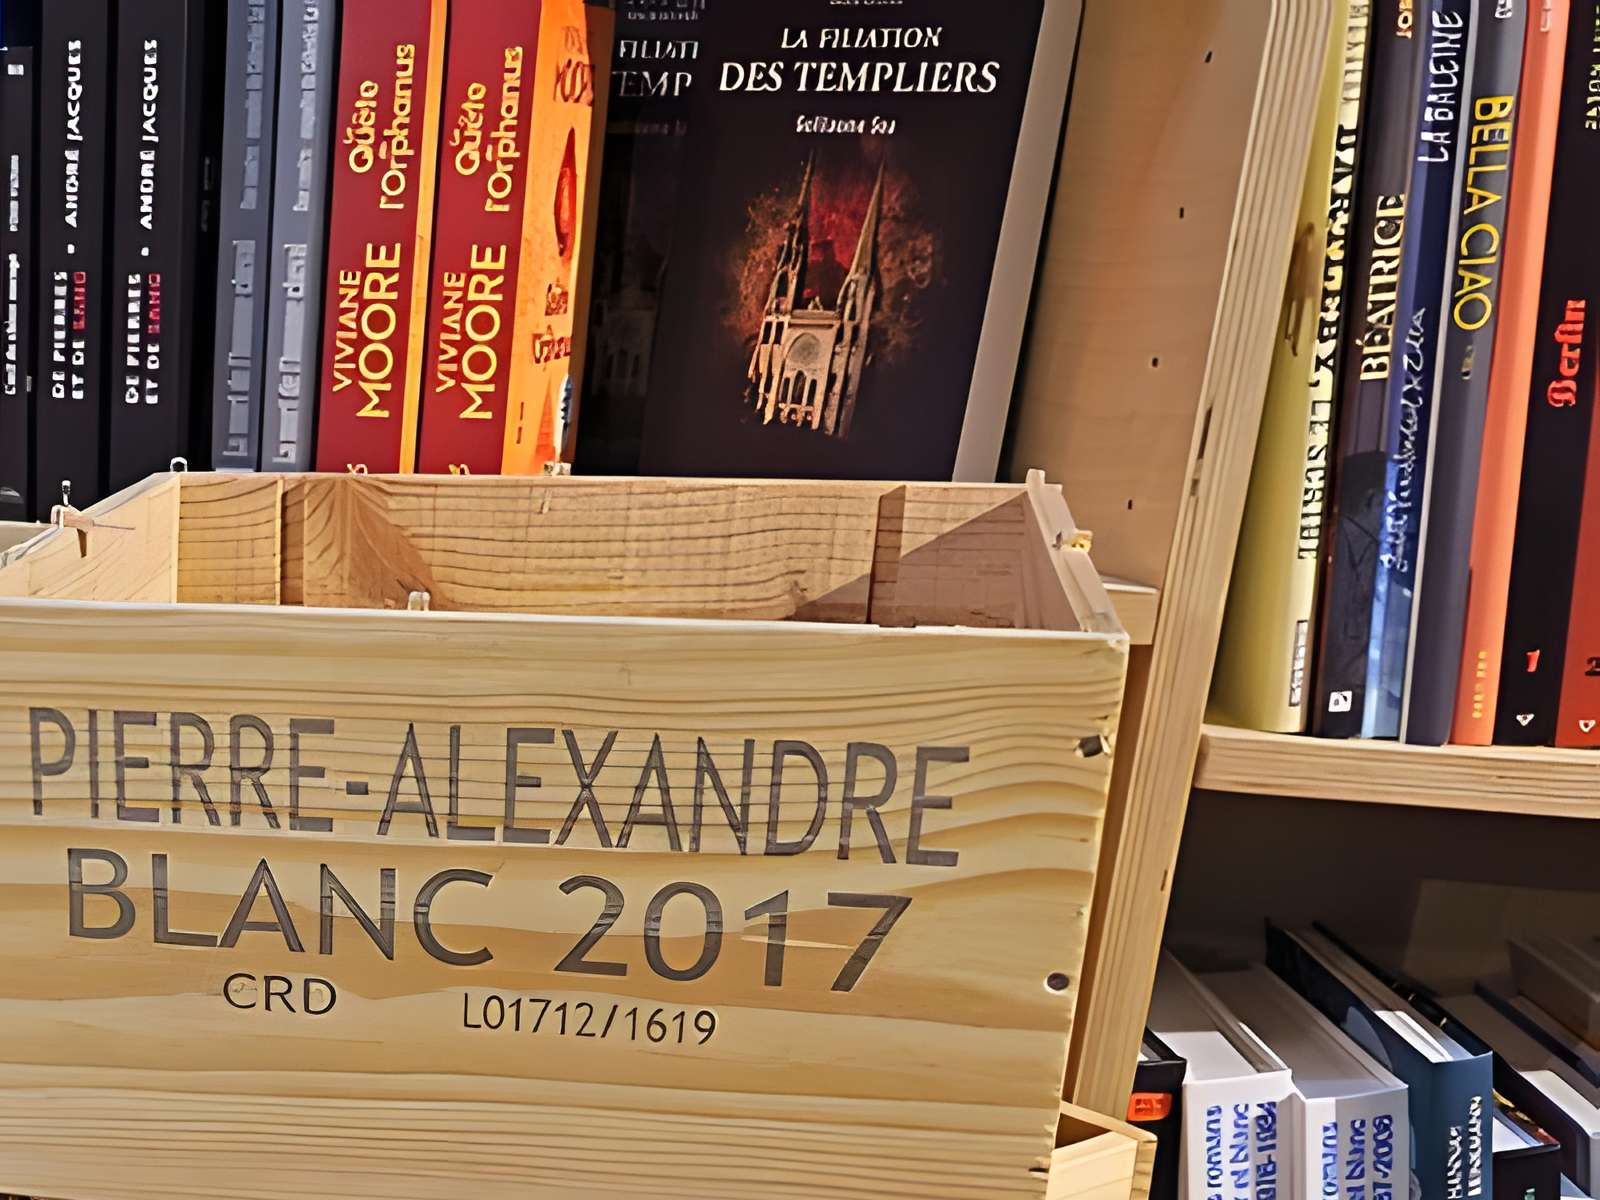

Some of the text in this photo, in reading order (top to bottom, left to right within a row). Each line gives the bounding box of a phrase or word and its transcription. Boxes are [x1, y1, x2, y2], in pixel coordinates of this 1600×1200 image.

[67, 40, 83, 141] JACQUES
[142, 40, 160, 142] JACQUES
[719, 60, 1001, 93] DES TEMPLIERS
[781, 27, 944, 49] LA FILIATION
[1417, 10, 1464, 163] LA BALEINE
[1453, 95, 1514, 332] BELLA CIAO
[332, 270, 362, 391] VIVIANE
[356, 243, 401, 417] MOORE
[435, 272, 467, 392] VIVIANE
[459, 244, 507, 419] MOORE
[1357, 193, 1406, 382] BÉATRICE
[1546, 299, 1586, 408] Berlin
[29, 707, 971, 867] PIERRE-ALEXANDRE
[67, 847, 913, 993] BLANC 2017
[223, 973, 718, 1046] CRD L01712/1619
